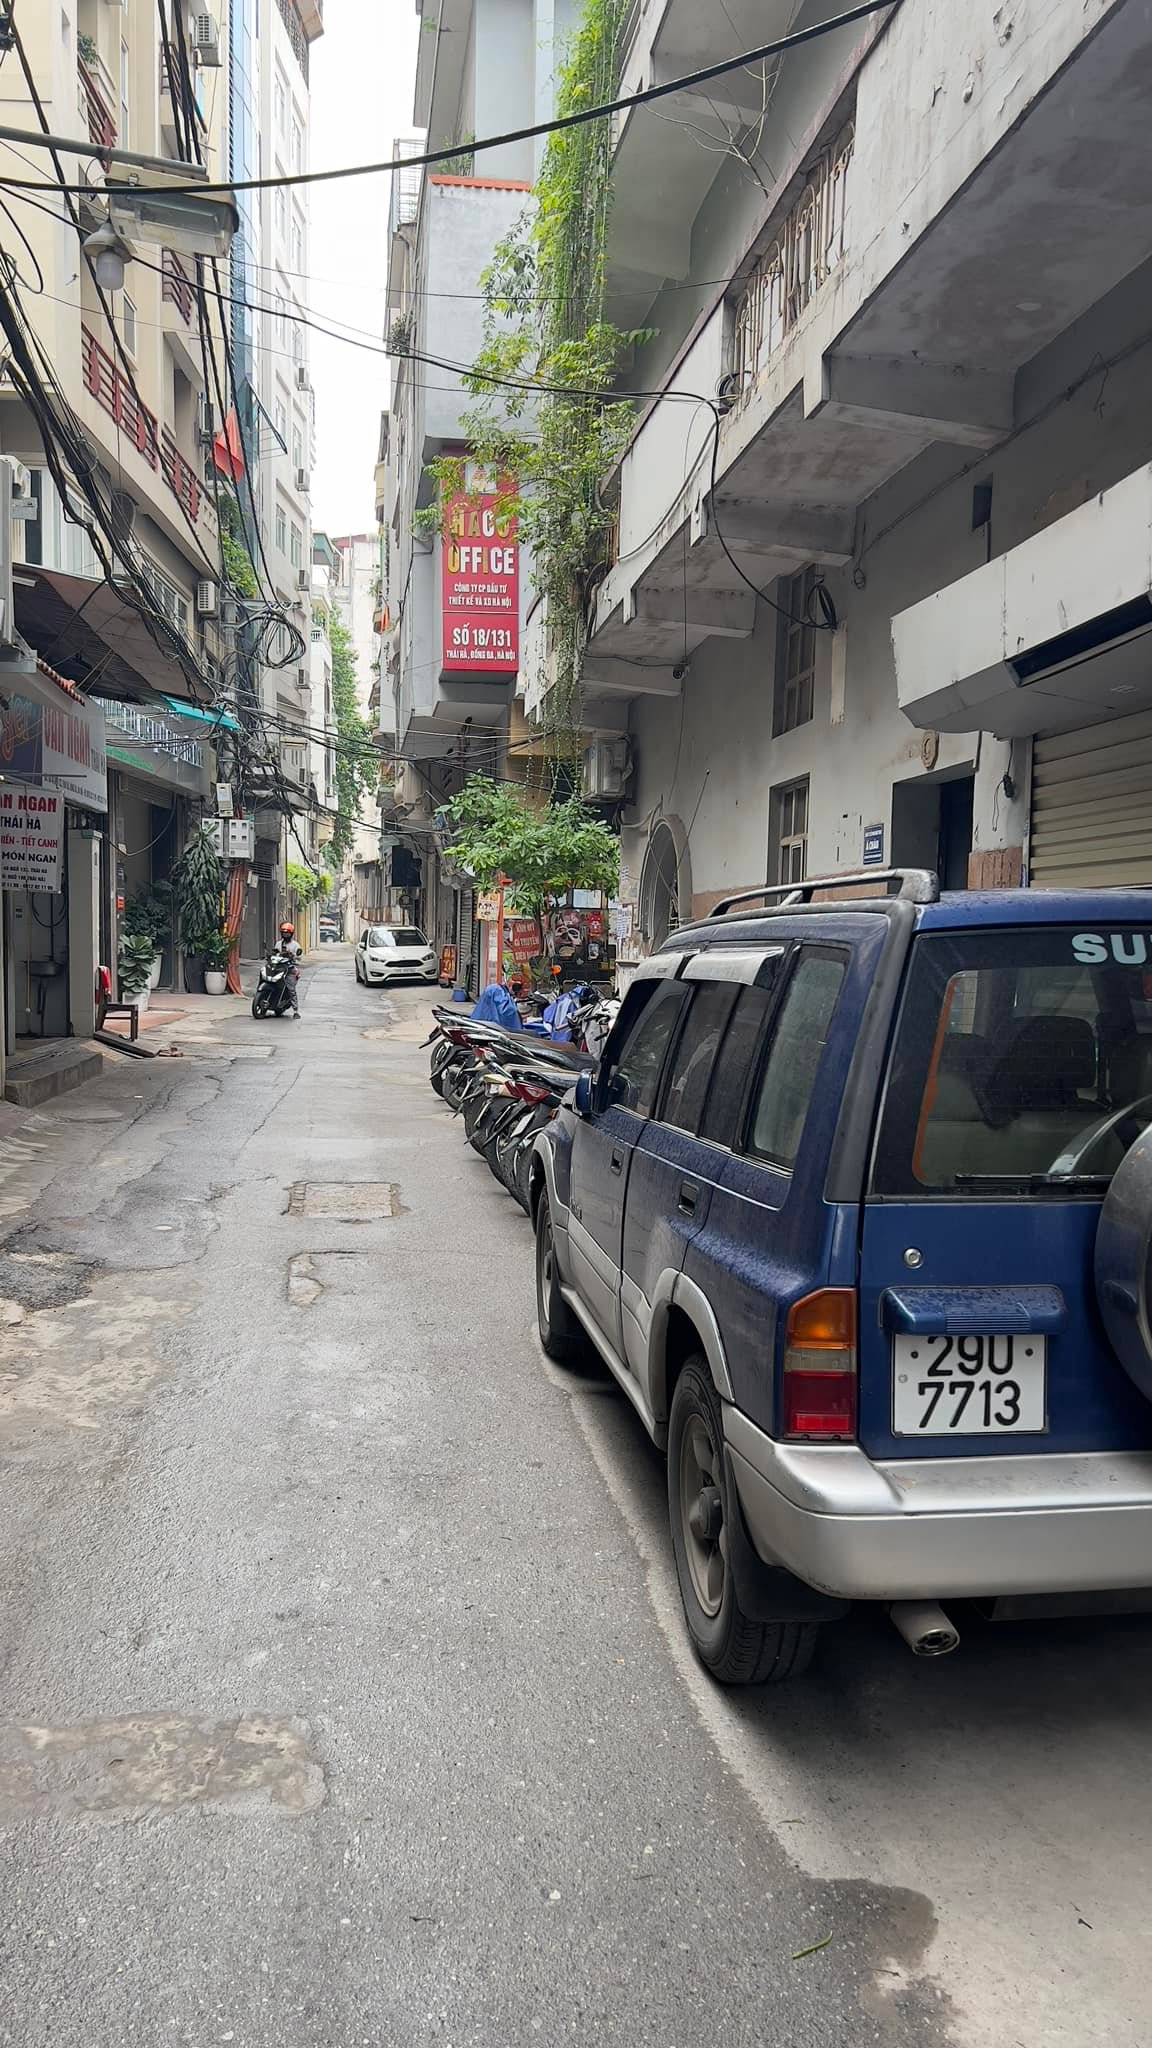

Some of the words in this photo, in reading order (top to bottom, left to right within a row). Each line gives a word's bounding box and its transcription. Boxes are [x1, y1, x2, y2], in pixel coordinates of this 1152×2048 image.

[448, 546, 515, 574] OFFICE
[453, 622, 470, 646] SỐ
[472, 629, 511, 647] 18/131
[18, 795, 57, 813] NGAN
[37, 838, 58, 848] CANH
[28, 853, 57, 864] NGAN
[1071, 933, 1152, 965] SU
[927, 1335, 1014, 1377] 29U
[918, 1380, 1021, 1428] 7713
